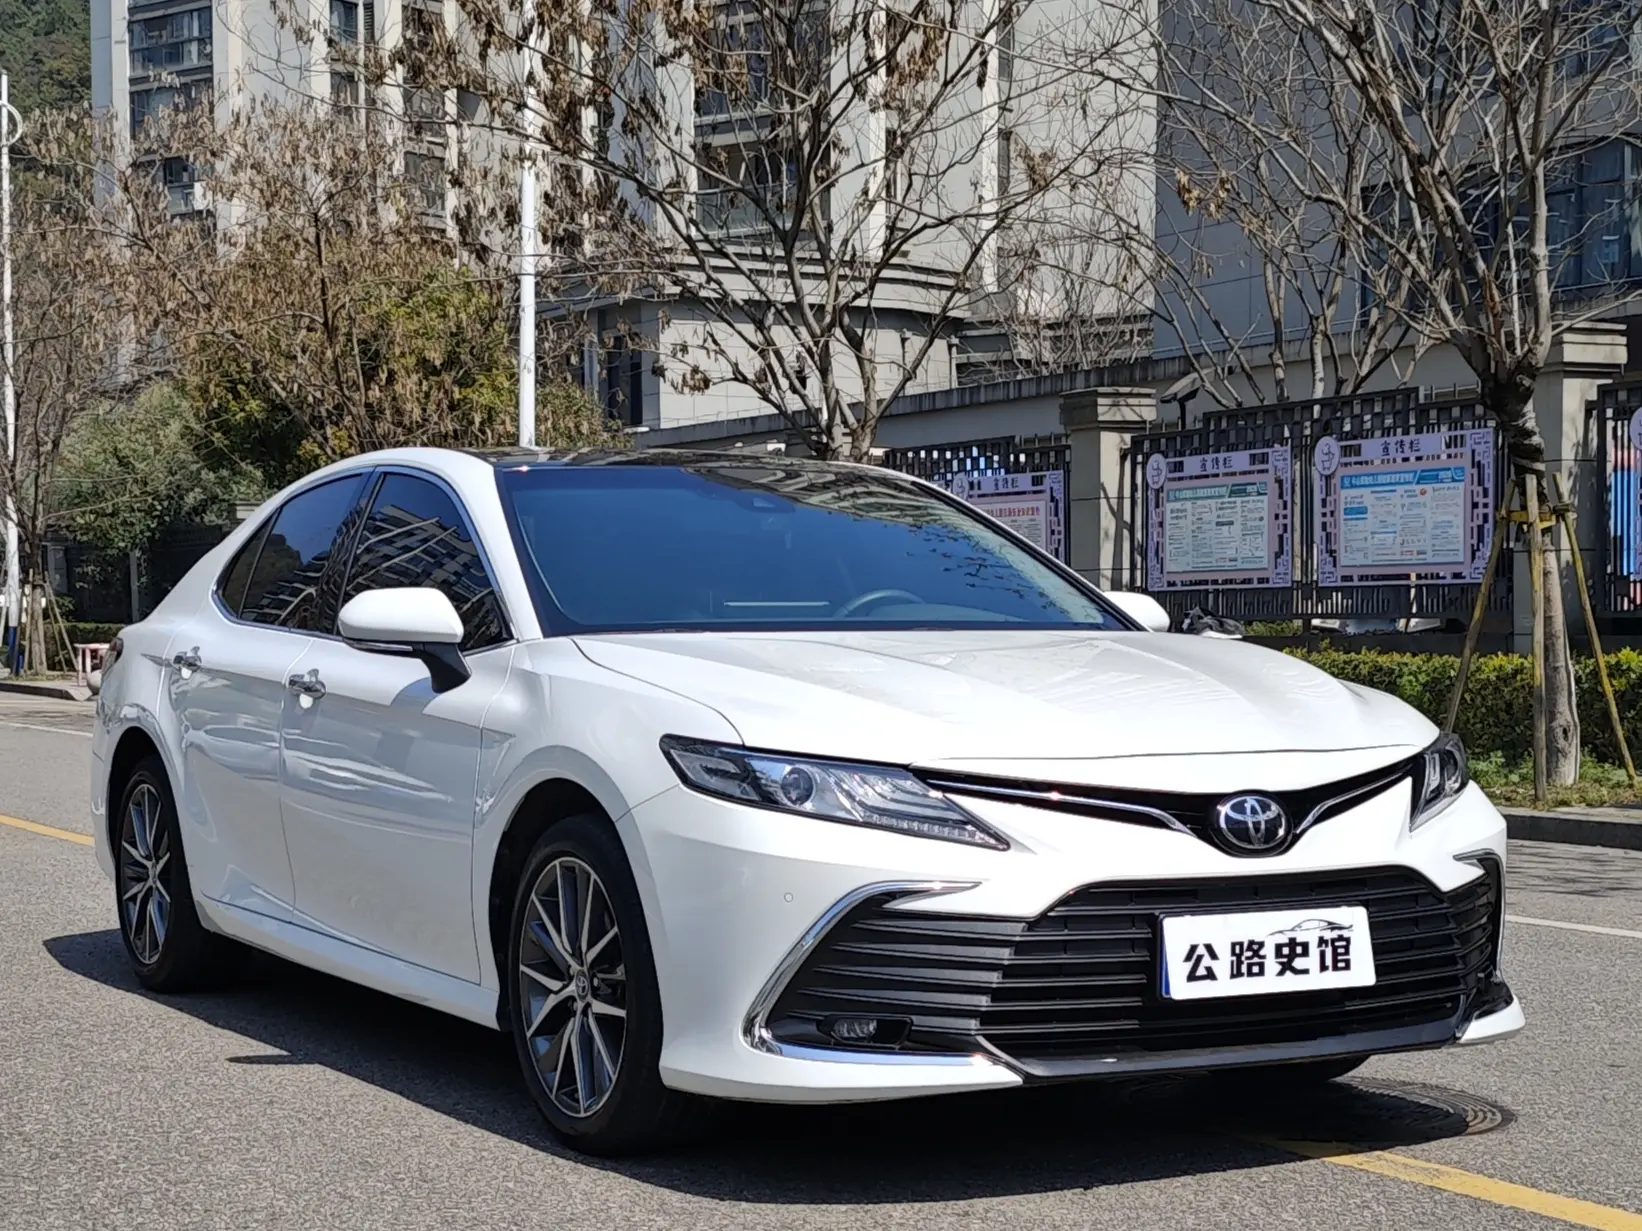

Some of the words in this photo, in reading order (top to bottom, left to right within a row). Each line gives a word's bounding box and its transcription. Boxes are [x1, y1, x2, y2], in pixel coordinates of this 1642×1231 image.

[1381, 438, 1421, 456] 宣传栏
[1199, 456, 1233, 472] 宣传栏
[1183, 934, 1352, 983] 公路史馆
